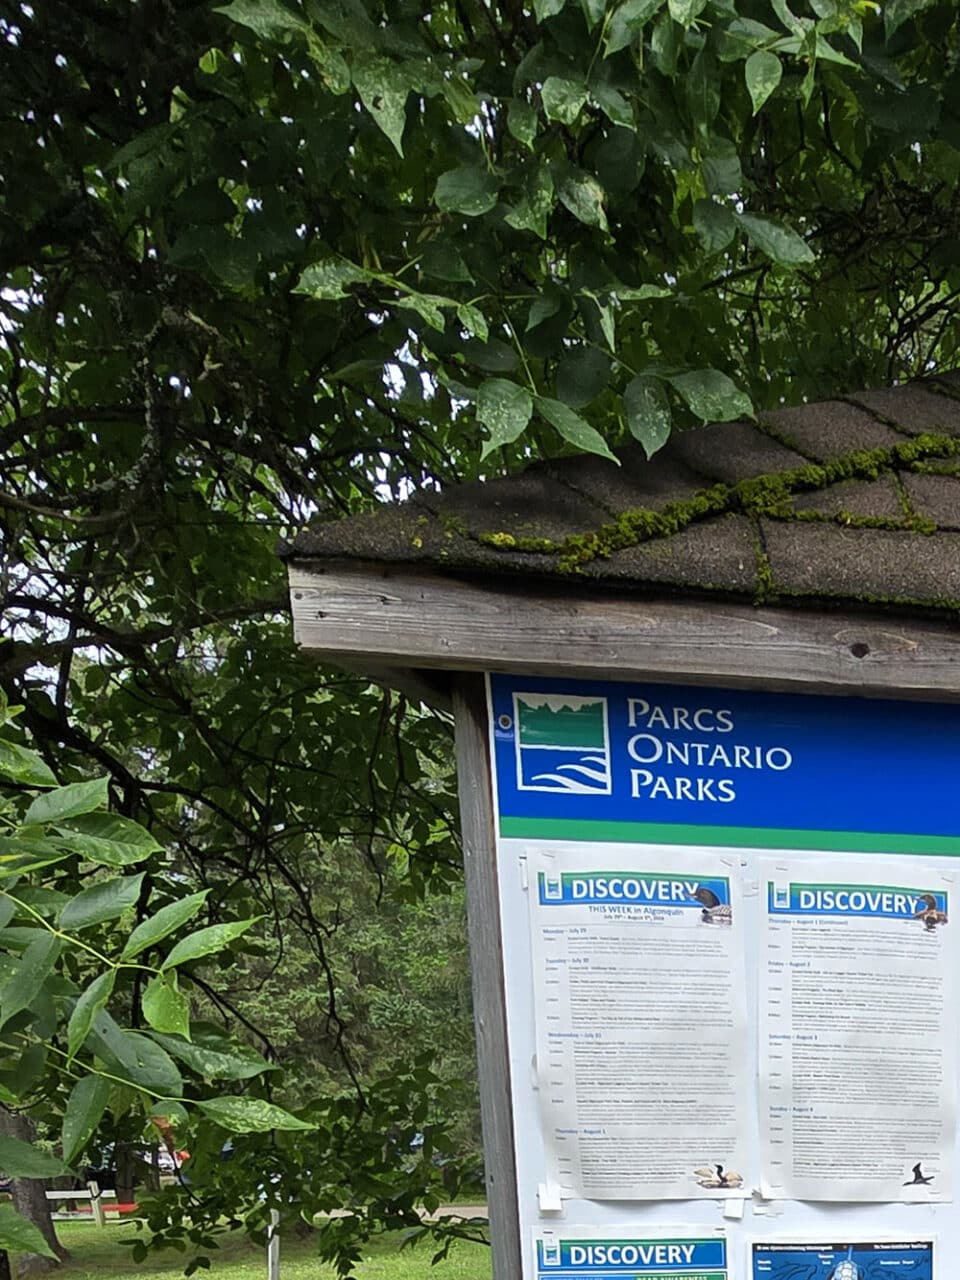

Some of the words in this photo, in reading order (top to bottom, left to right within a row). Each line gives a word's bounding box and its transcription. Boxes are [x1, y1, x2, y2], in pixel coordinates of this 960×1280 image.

[628, 698, 734, 732] PARCS
[627, 733, 793, 771] ONTARIO
[631, 769, 736, 802] PARKS
[573, 879, 699, 900] DISCOVERY
[608, 906, 632, 914] WEEK
[800, 891, 918, 914] DISCOVERY
[571, 1245, 696, 1265] DISCOVERY
